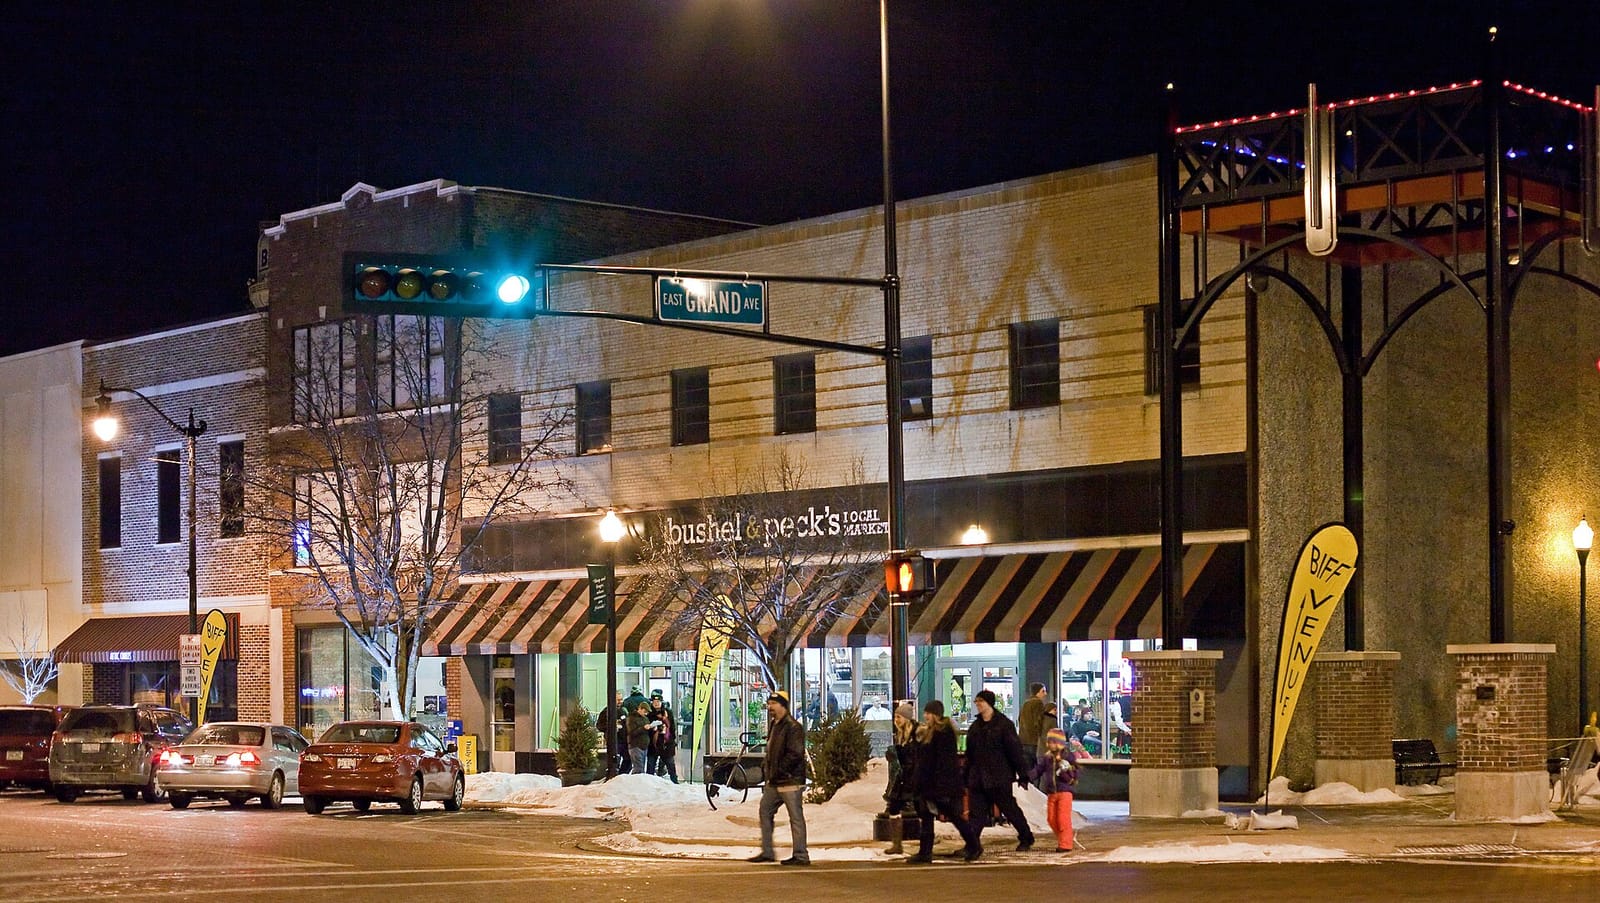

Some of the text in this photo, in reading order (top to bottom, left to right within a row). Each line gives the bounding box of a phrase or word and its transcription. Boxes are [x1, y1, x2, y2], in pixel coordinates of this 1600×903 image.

[663, 287, 760, 315] EAST GRAND AVE
[667, 505, 841, 548] bushel & peck's
[843, 509, 881, 523] LOCAL
[843, 521, 889, 536] MARKET
[1310, 544, 1352, 583] BIFF
[206, 621, 225, 641] BIFF
[182, 644, 201, 652] PARKING
[1281, 588, 1334, 716] VENUE
[185, 675, 197, 683] HOUR
[699, 636, 723, 721] VENUE
